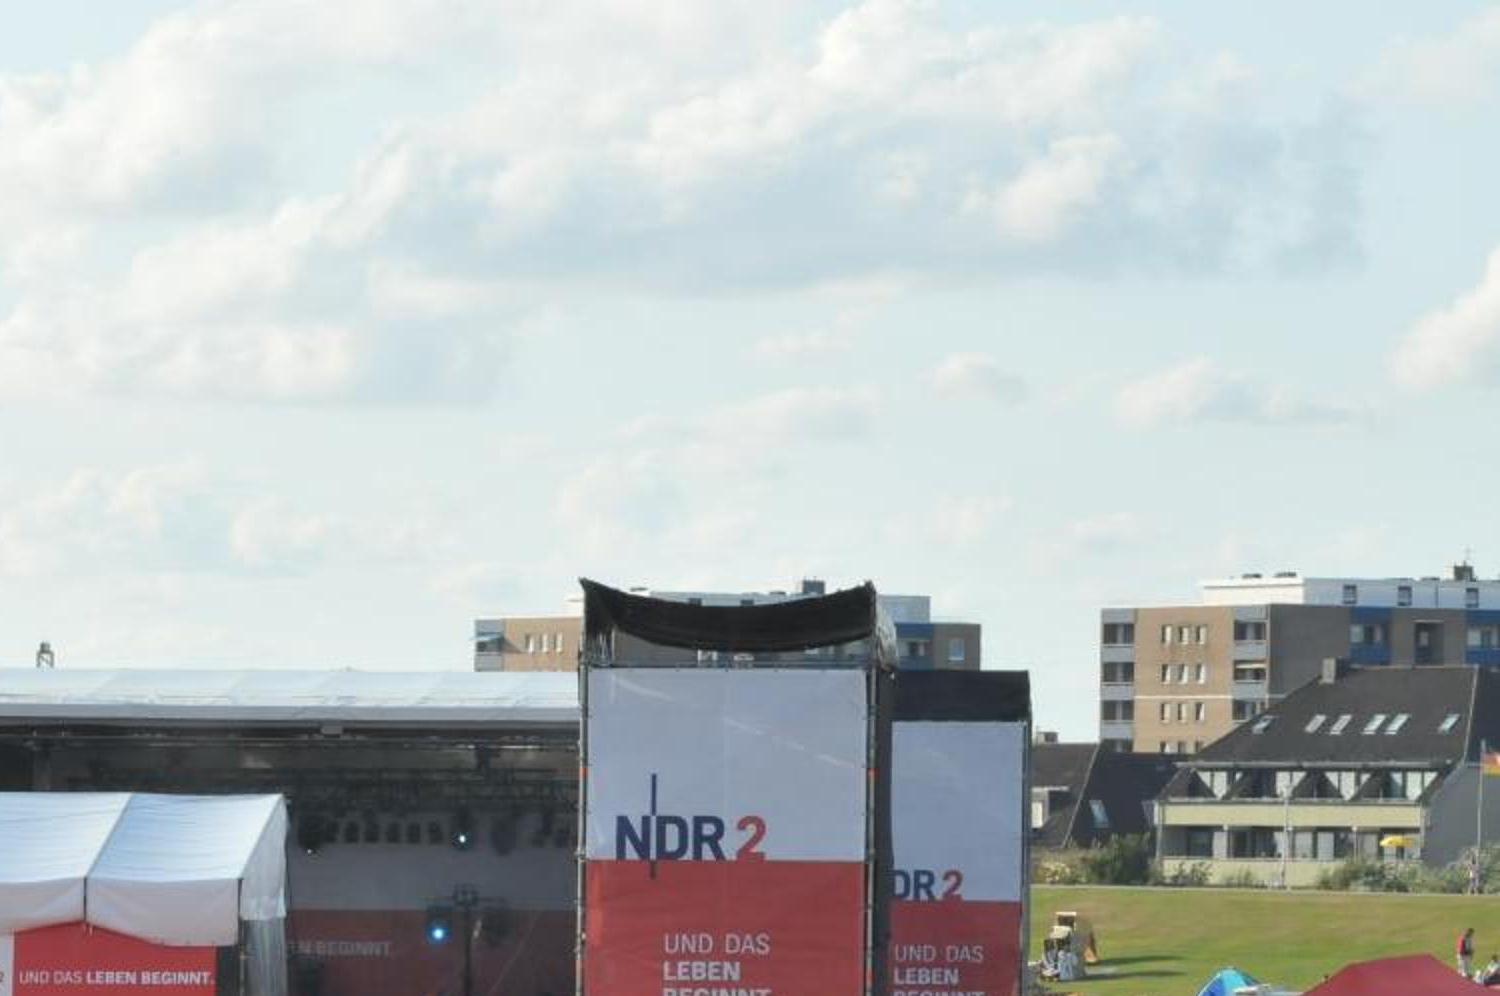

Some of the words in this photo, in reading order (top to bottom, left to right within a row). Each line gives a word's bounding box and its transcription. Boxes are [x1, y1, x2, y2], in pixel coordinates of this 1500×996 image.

[615, 815, 726, 861] NDR
[736, 815, 768, 861] 2
[892, 869, 936, 900] DR
[941, 869, 964, 900] 2
[664, 933, 713, 954] UND
[725, 933, 770, 955] DAS
[894, 944, 937, 961] UND
[946, 945, 985, 963] DAS
[19, 970, 49, 985] UND
[53, 970, 83, 985] DAS
[86, 970, 137, 985] LEBEN
[141, 970, 215, 985] BEGINNT.
[662, 960, 741, 982] LEBEN
[893, 967, 959, 986] LEBEN
